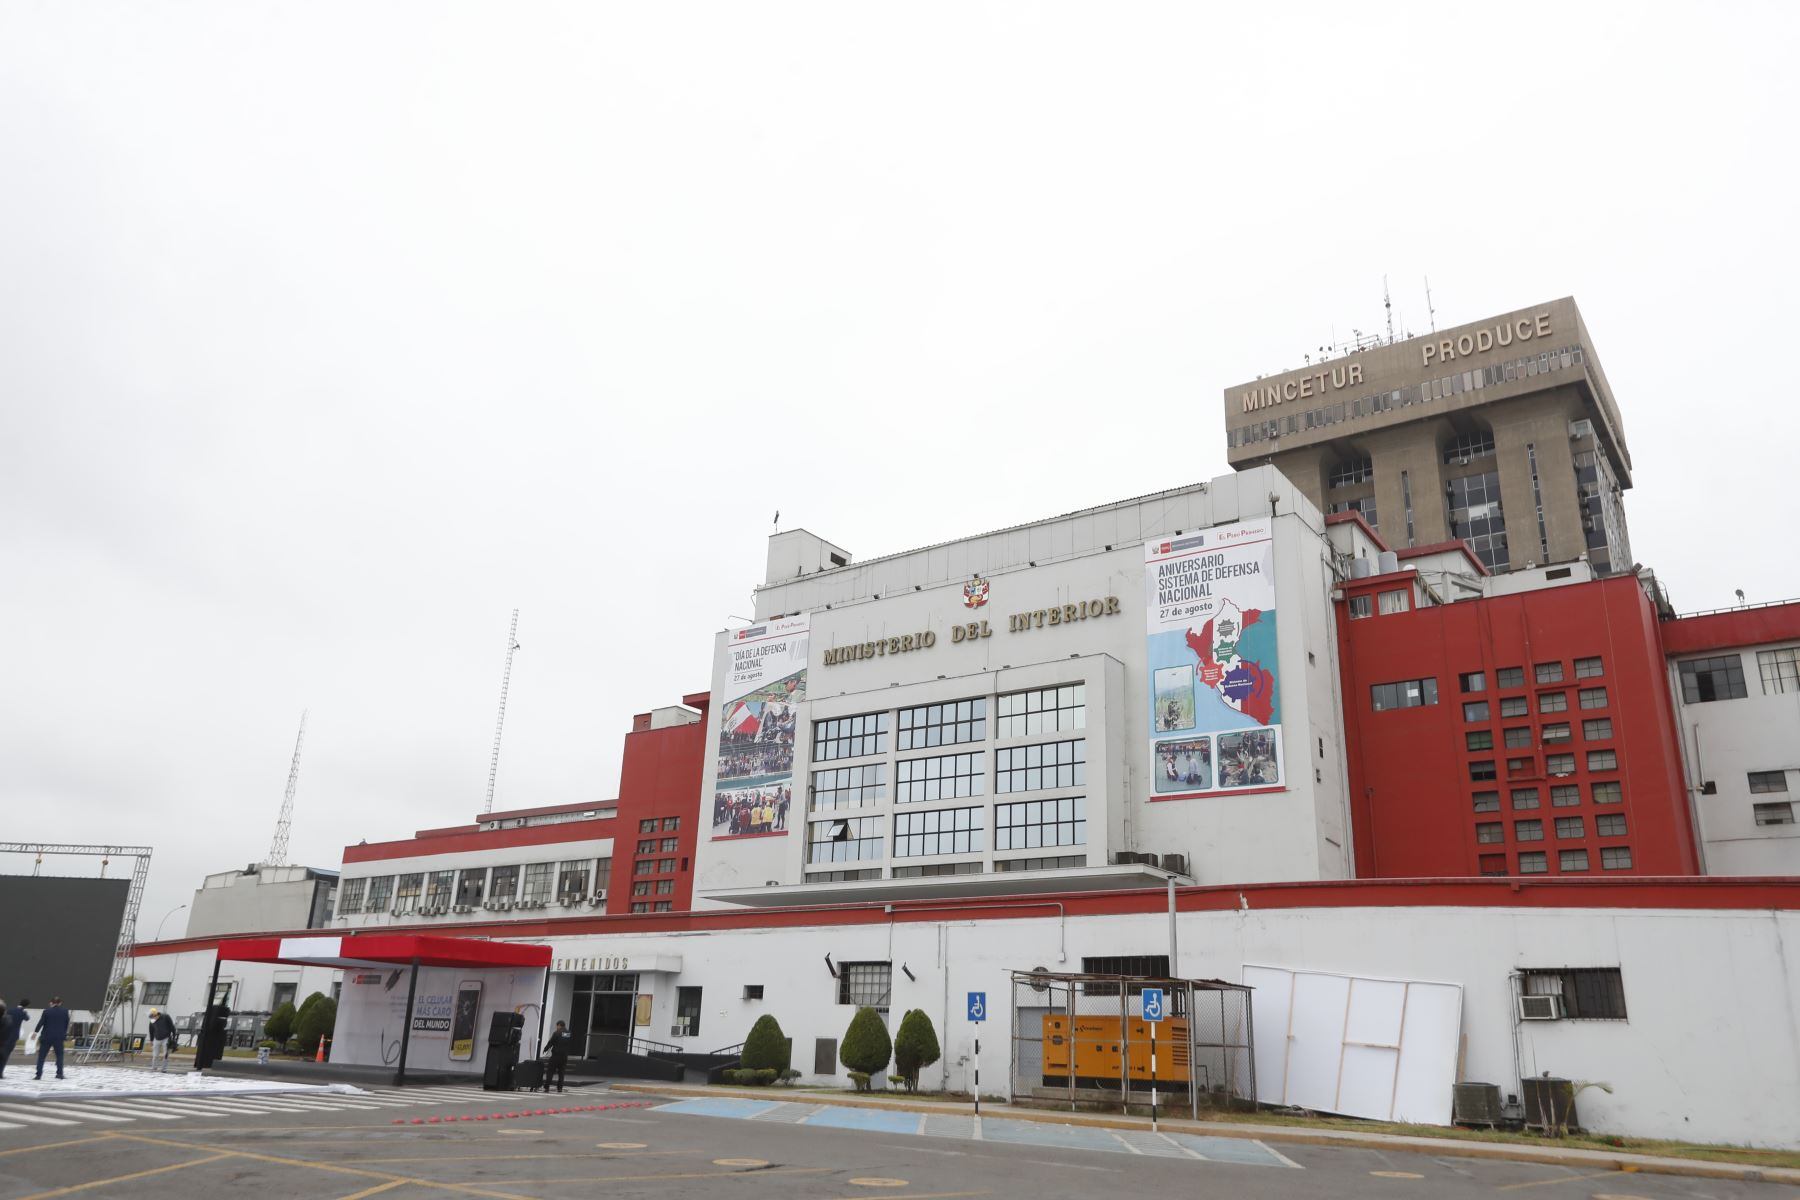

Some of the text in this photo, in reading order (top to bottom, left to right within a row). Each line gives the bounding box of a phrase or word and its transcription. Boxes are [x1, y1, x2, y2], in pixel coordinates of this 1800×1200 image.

[1422, 313, 1552, 366] PRODUCE
[1242, 363, 1364, 413] MINCETUR
[1158, 553, 1224, 578] ANIVERSARIO
[1158, 561, 1260, 591] SISTEMA DE DEFENSA
[1159, 583, 1212, 605] NACIONAL
[1160, 602, 1213, 619] 27 de agosto
[823, 596, 1122, 666] MINISTERIO DEL INTERIOR
[745, 648, 753, 659] DE
[753, 646, 760, 658] LA
[760, 642, 787, 656] DEFENSA
[551, 957, 629, 971] IENVENIDOS
[418, 995, 453, 1005] EL CELULAR
[432, 1006, 452, 1016] CARO
[413, 1019, 450, 1029] DEL MUNDO
